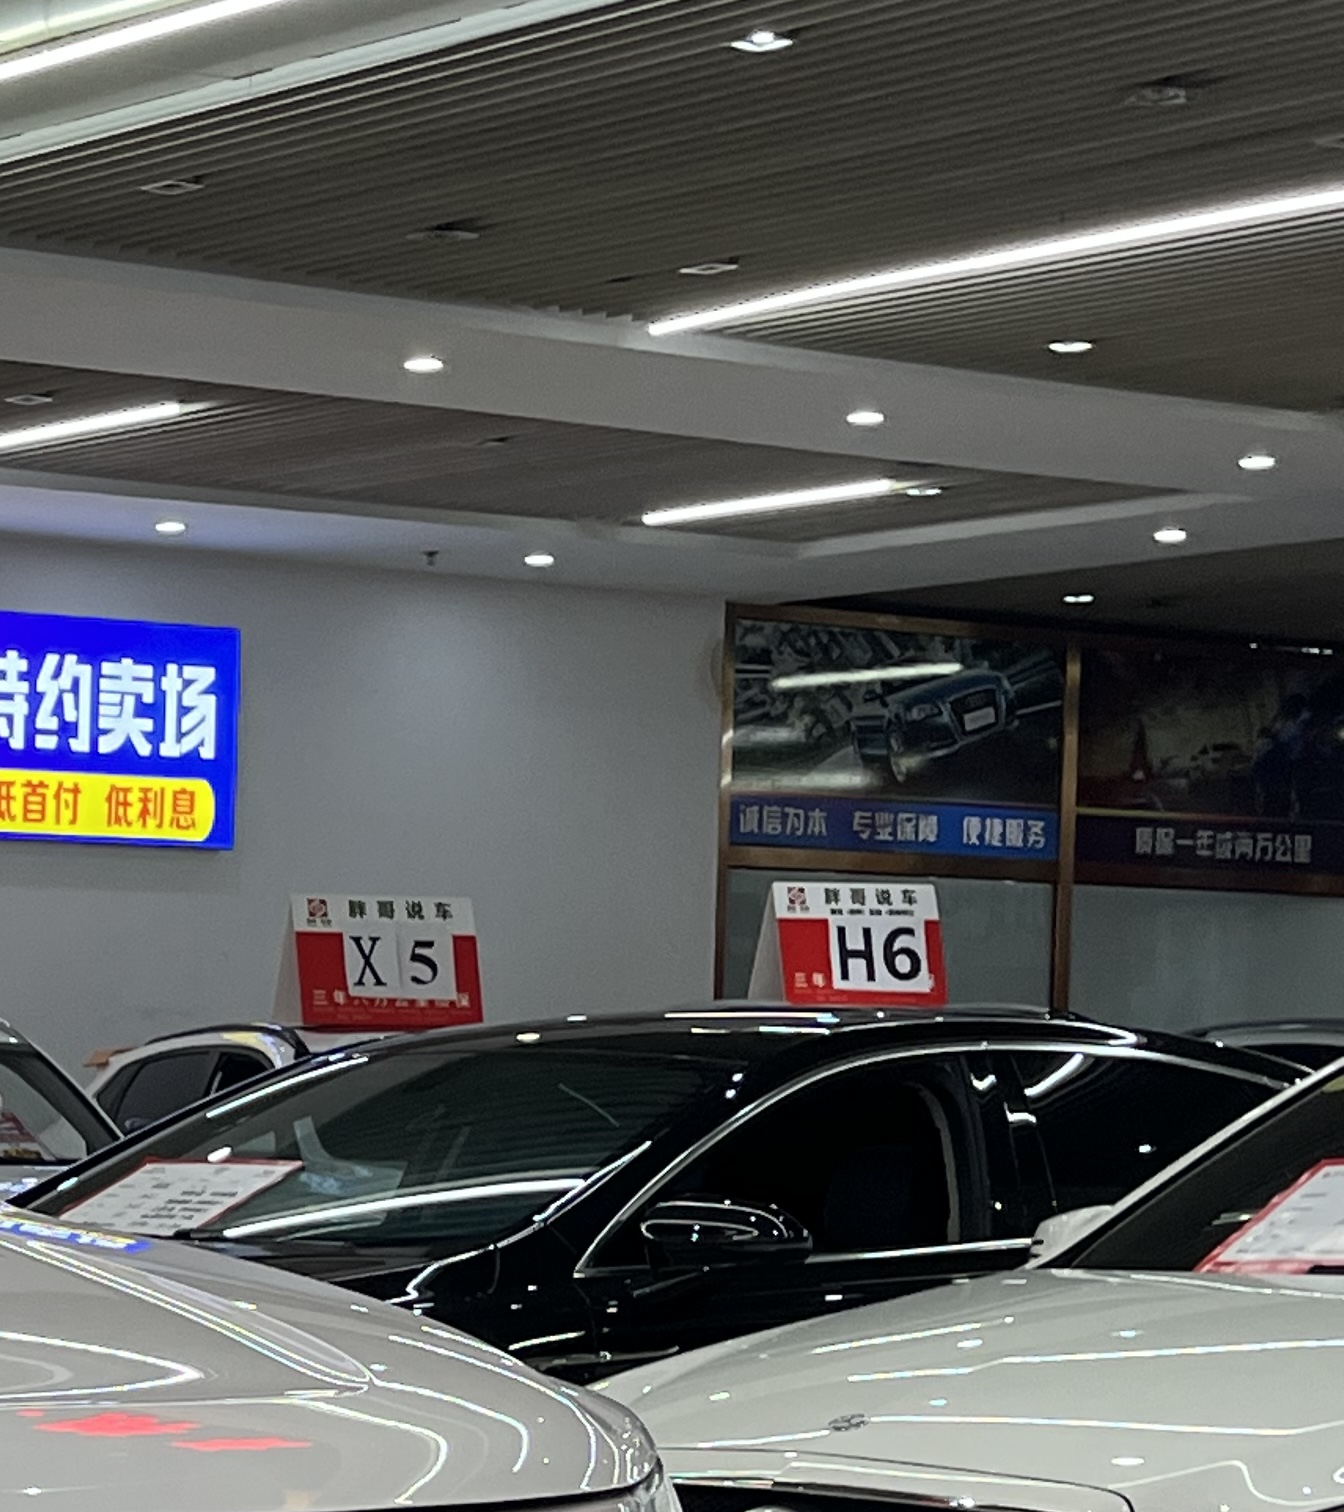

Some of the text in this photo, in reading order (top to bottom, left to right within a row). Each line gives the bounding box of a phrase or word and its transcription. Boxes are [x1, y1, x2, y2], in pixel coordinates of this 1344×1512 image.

[104, 783, 198, 832] 低利息
[738, 804, 828, 837] 诚信为本
[836, 925, 922, 982] H6
